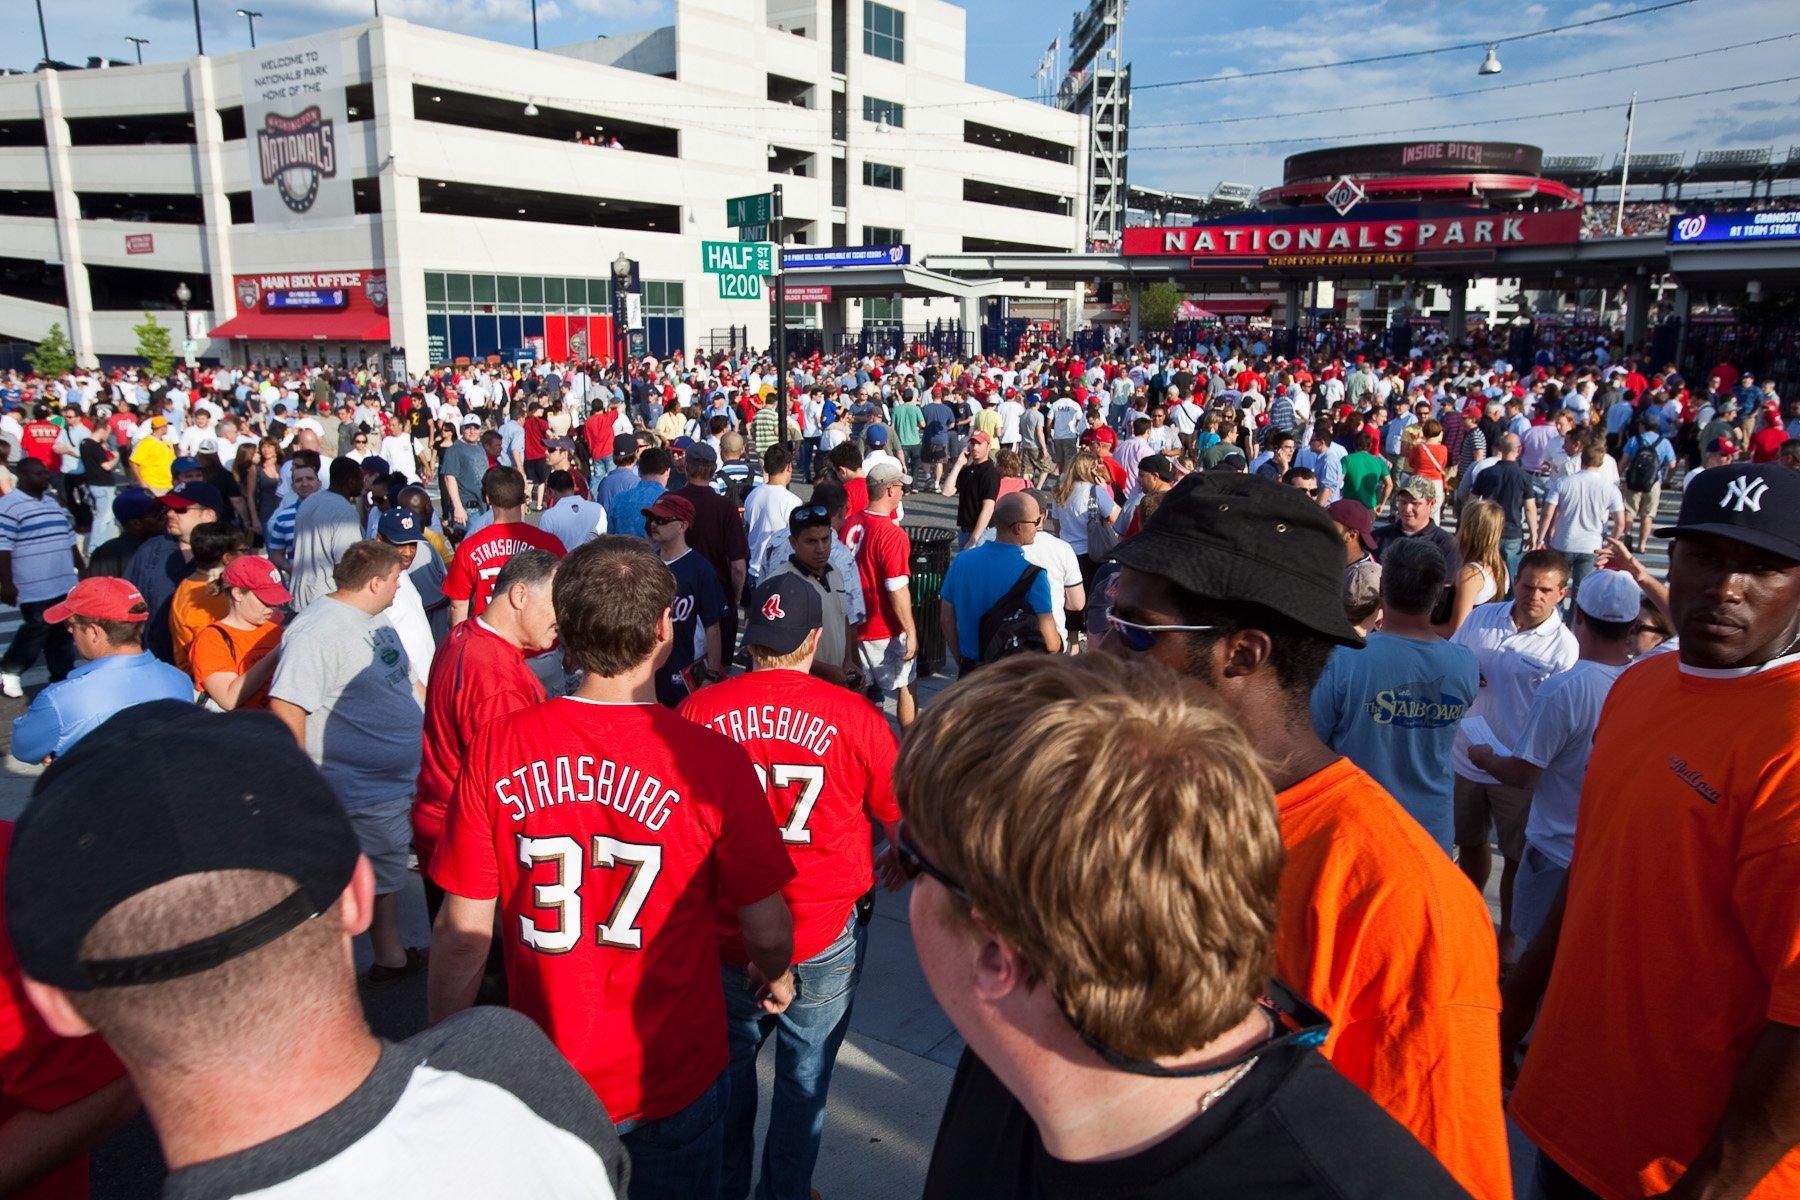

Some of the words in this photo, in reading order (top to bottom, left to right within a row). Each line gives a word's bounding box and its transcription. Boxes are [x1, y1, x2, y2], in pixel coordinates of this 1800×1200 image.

[261, 55, 303, 71] WELCOME
[306, 51, 318, 63] TO
[254, 69, 301, 87] NATIONALS
[304, 65, 327, 78] PARK
[262, 88, 286, 100] HOME
[289, 86, 300, 97] OF
[303, 82, 321, 94] THE
[260, 125, 333, 180] NATIONALS
[1402, 143, 1444, 165] INSIDE
[1447, 143, 1483, 164] PITCH
[738, 200, 746, 222] N
[758, 196, 765, 208] ST
[758, 209, 766, 221] SE
[1165, 223, 1403, 251] NATIONALS
[1418, 217, 1526, 247] PARK
[1744, 225, 1768, 236] TEAM
[1769, 223, 1797, 235] STORE
[708, 245, 753, 270] HALF
[757, 246, 769, 258] ST
[757, 259, 769, 270] SE
[1267, 255, 1326, 266] CENTER
[1328, 254, 1372, 265] FIELD
[261, 276, 290, 289] MAIN
[291, 274, 316, 288] BOX
[317, 273, 362, 287] OFFICE
[720, 273, 759, 297] 1200
[704, 705, 838, 757] TRASBURG
[494, 755, 681, 832] STRASBURG
[516, 833, 663, 954] 37
